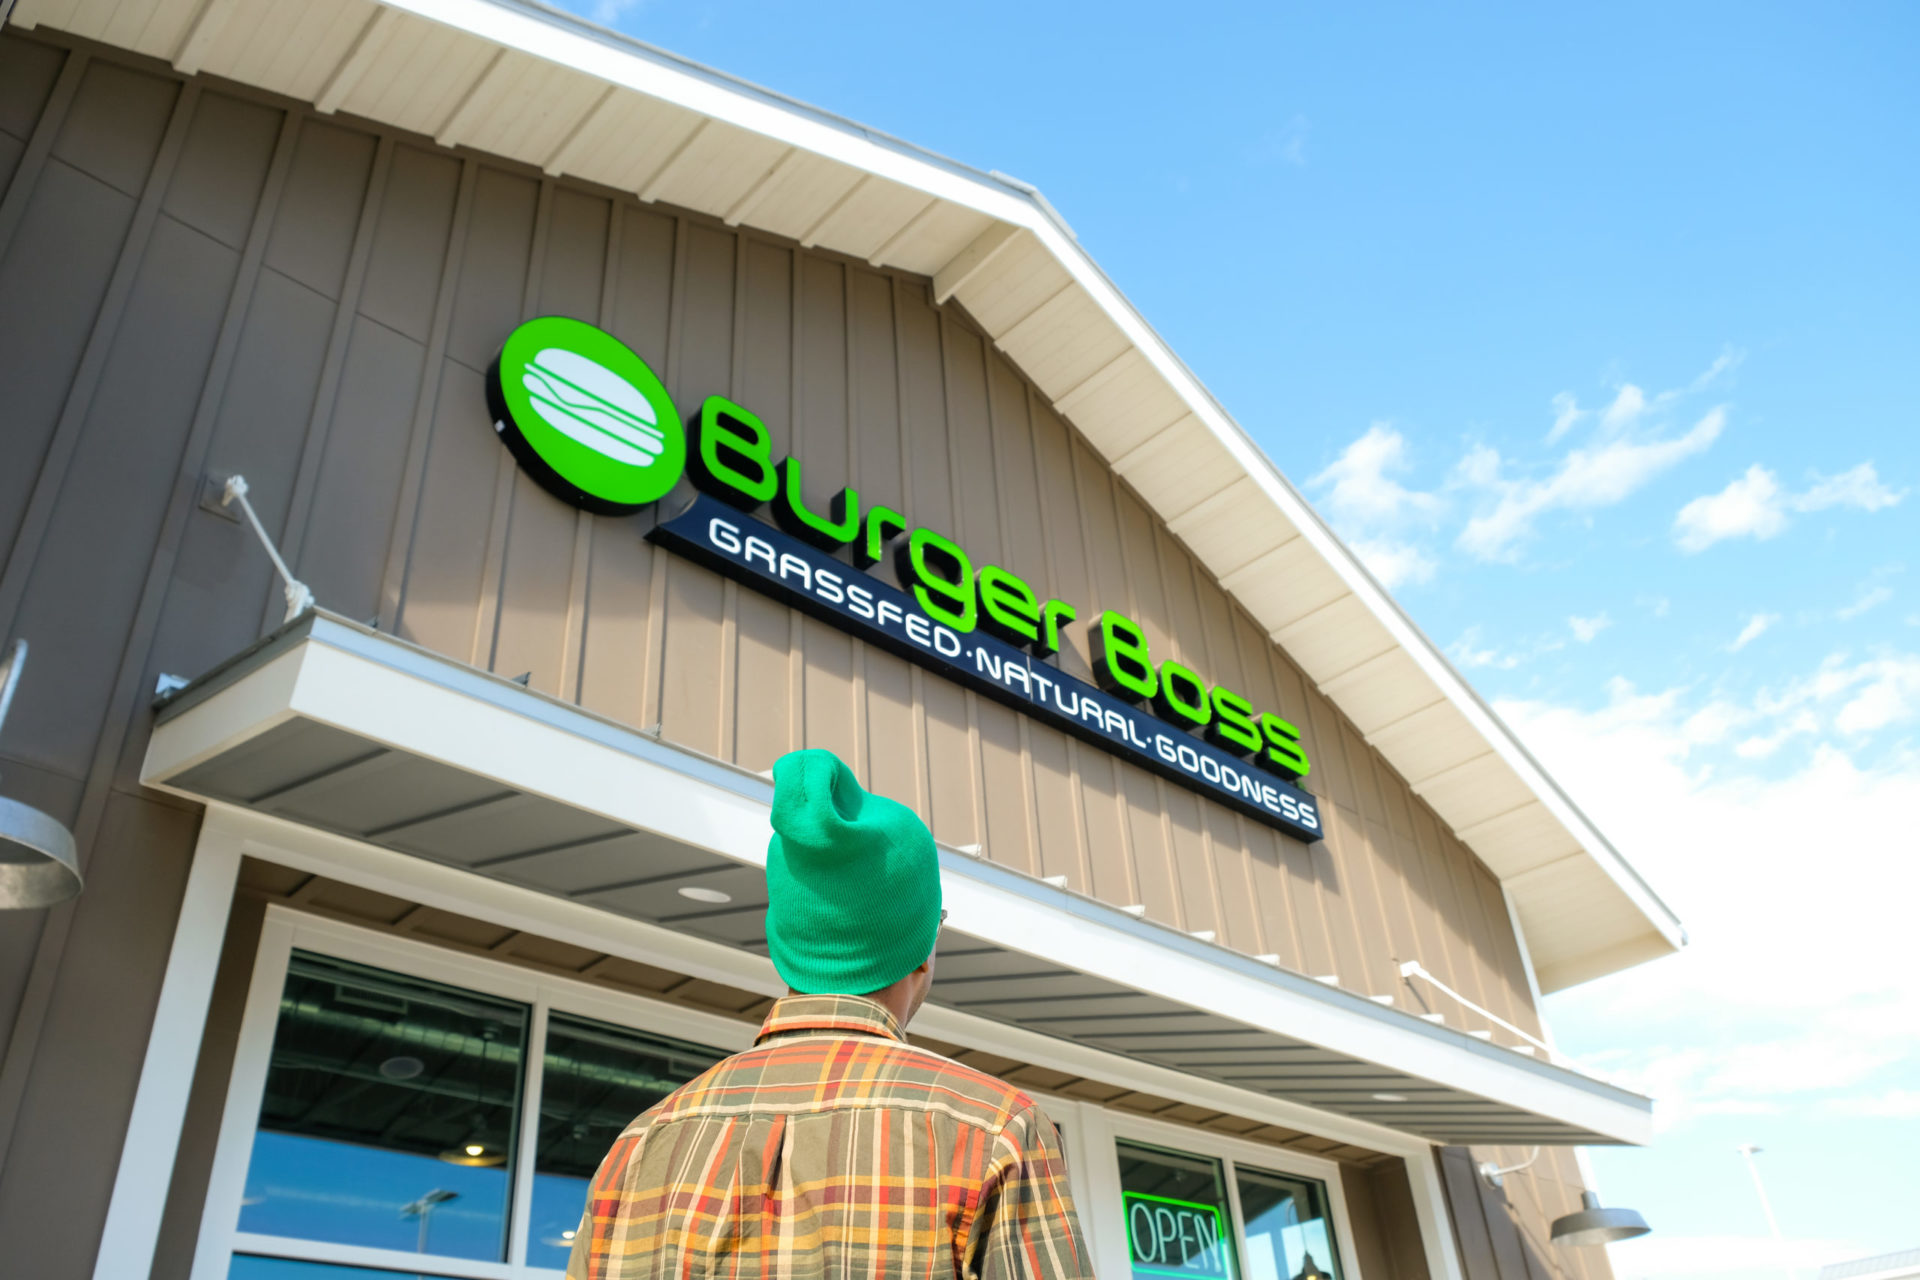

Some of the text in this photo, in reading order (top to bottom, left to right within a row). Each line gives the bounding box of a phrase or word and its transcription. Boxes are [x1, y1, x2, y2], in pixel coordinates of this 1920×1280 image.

[700, 395, 1310, 777] Burger Boss
[1130, 1203, 1222, 1273] OPEN
